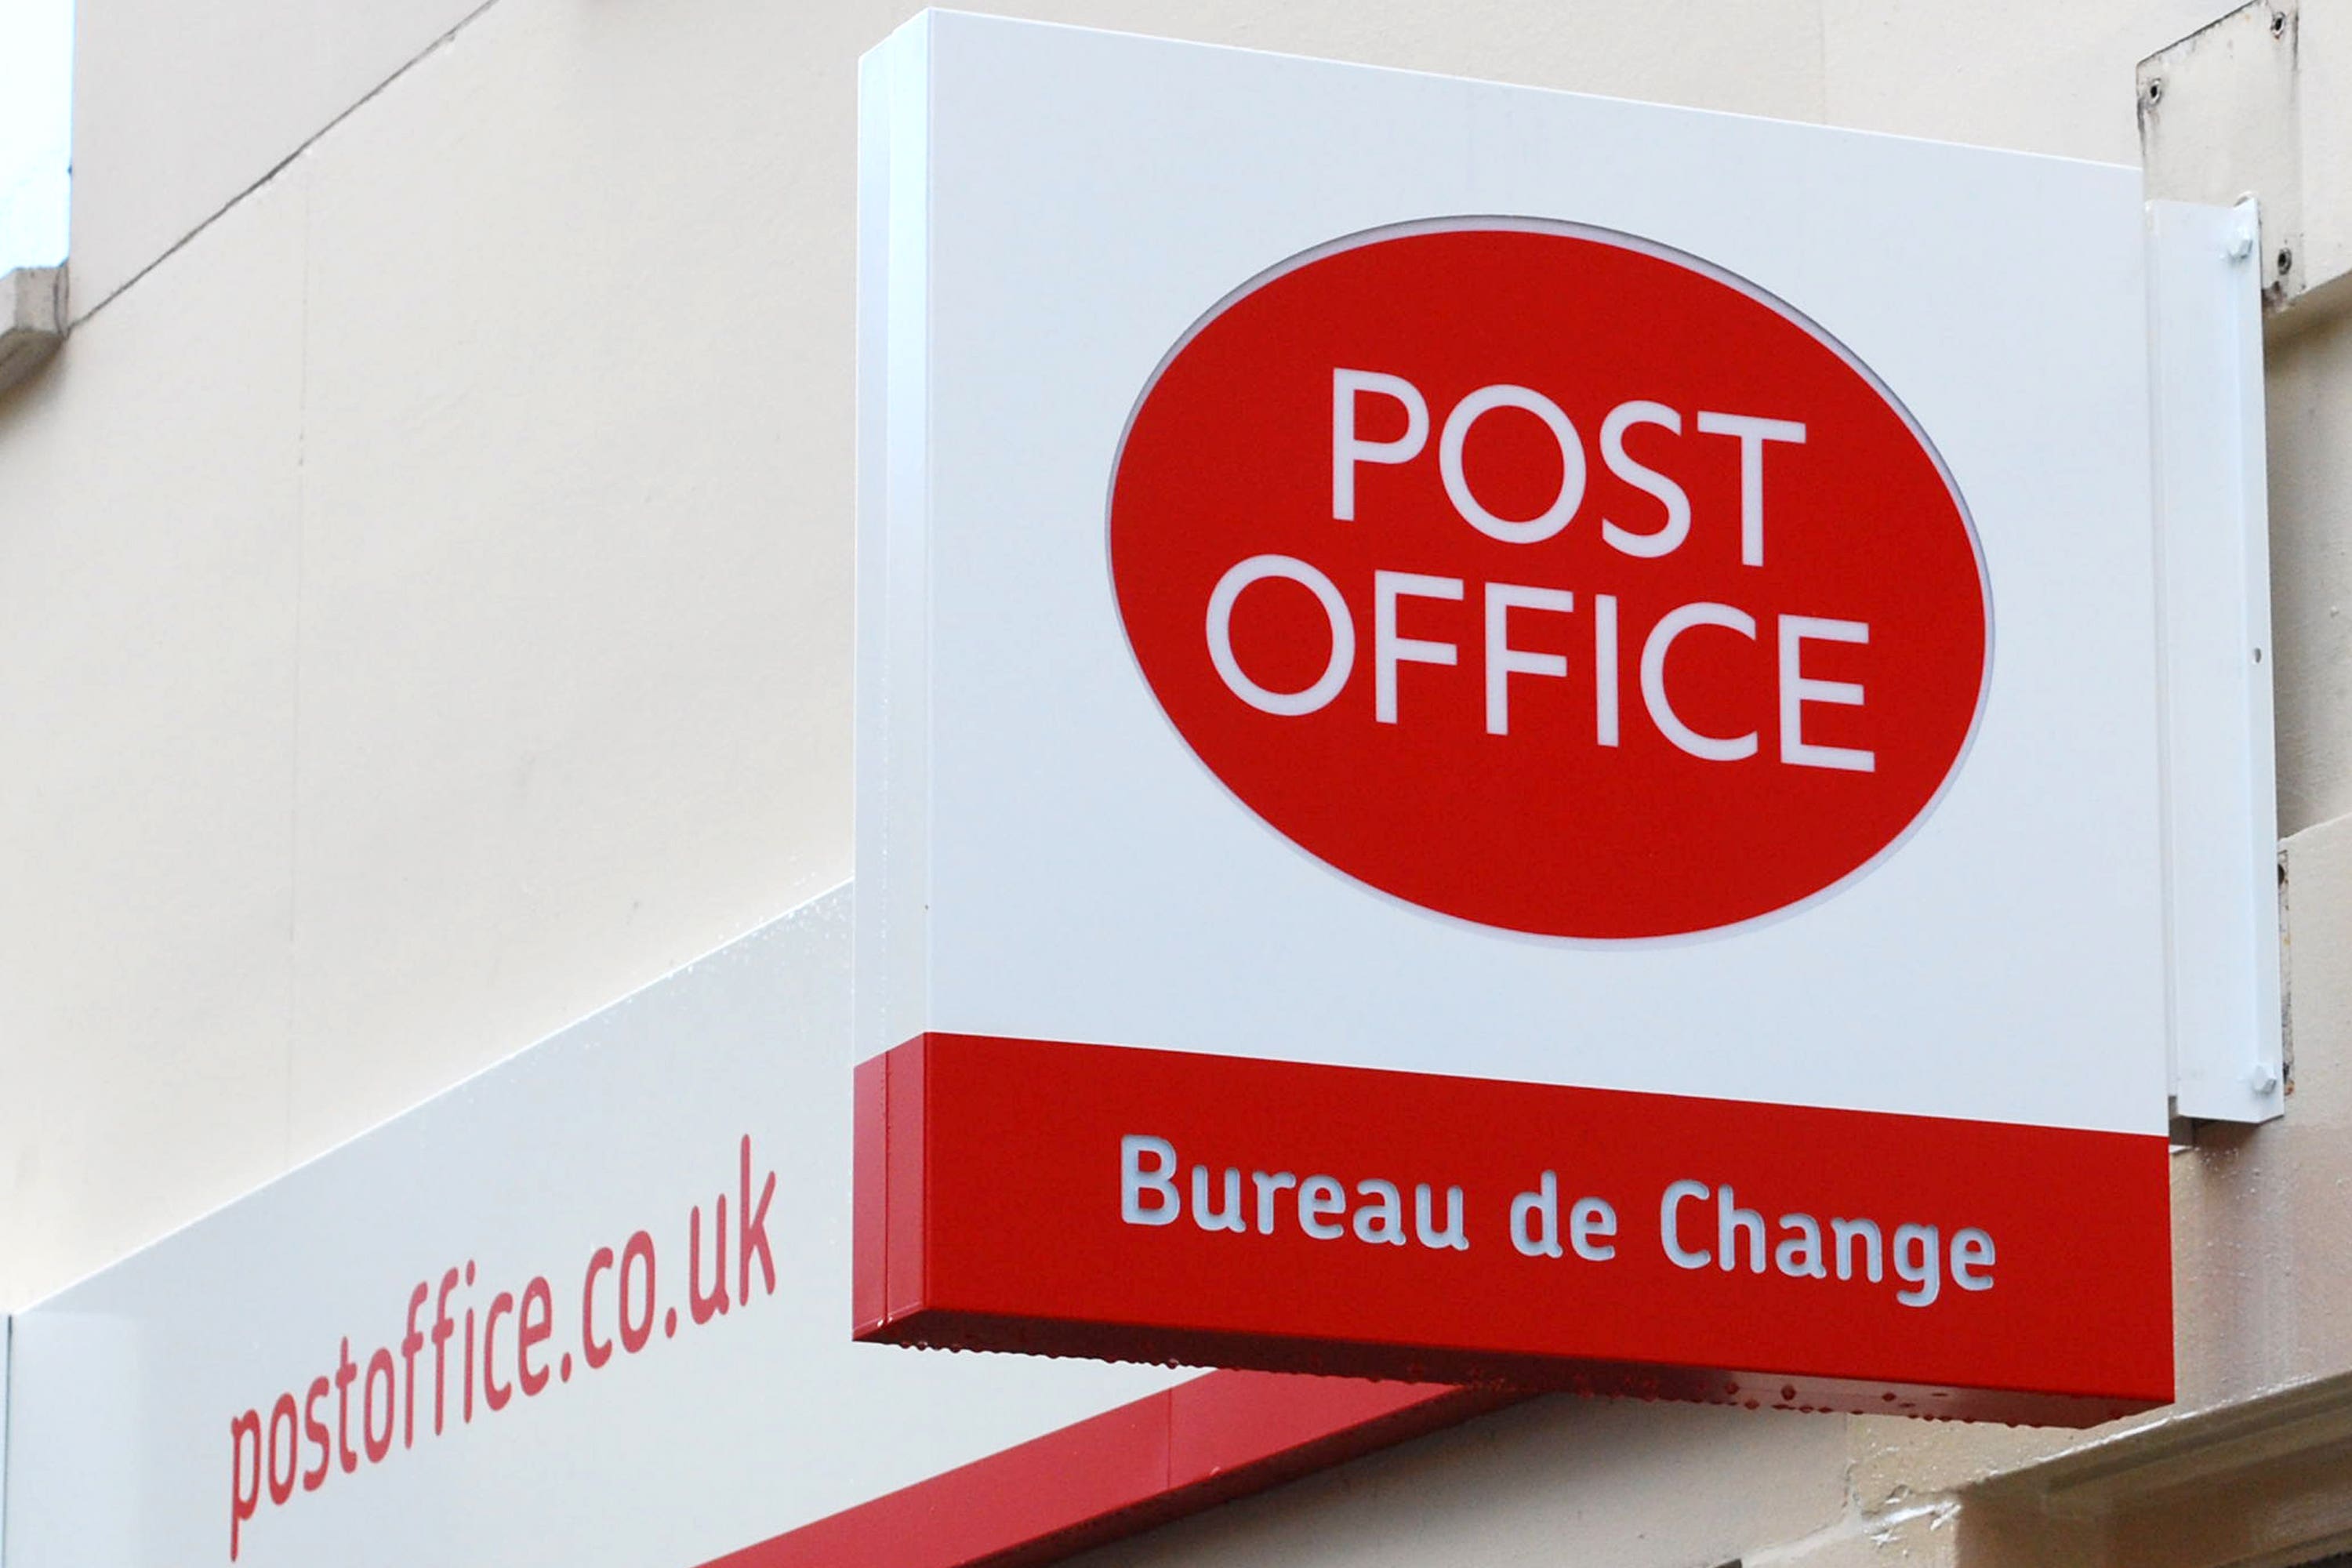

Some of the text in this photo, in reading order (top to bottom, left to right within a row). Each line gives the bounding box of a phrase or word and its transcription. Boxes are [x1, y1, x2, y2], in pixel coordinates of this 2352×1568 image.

[1332, 368, 1807, 568] POST
[1205, 554, 1875, 773] OFFICE
[1120, 1134, 1998, 1308] Bureau de Change
[230, 1134, 778, 1561] postoffice.co.uk
